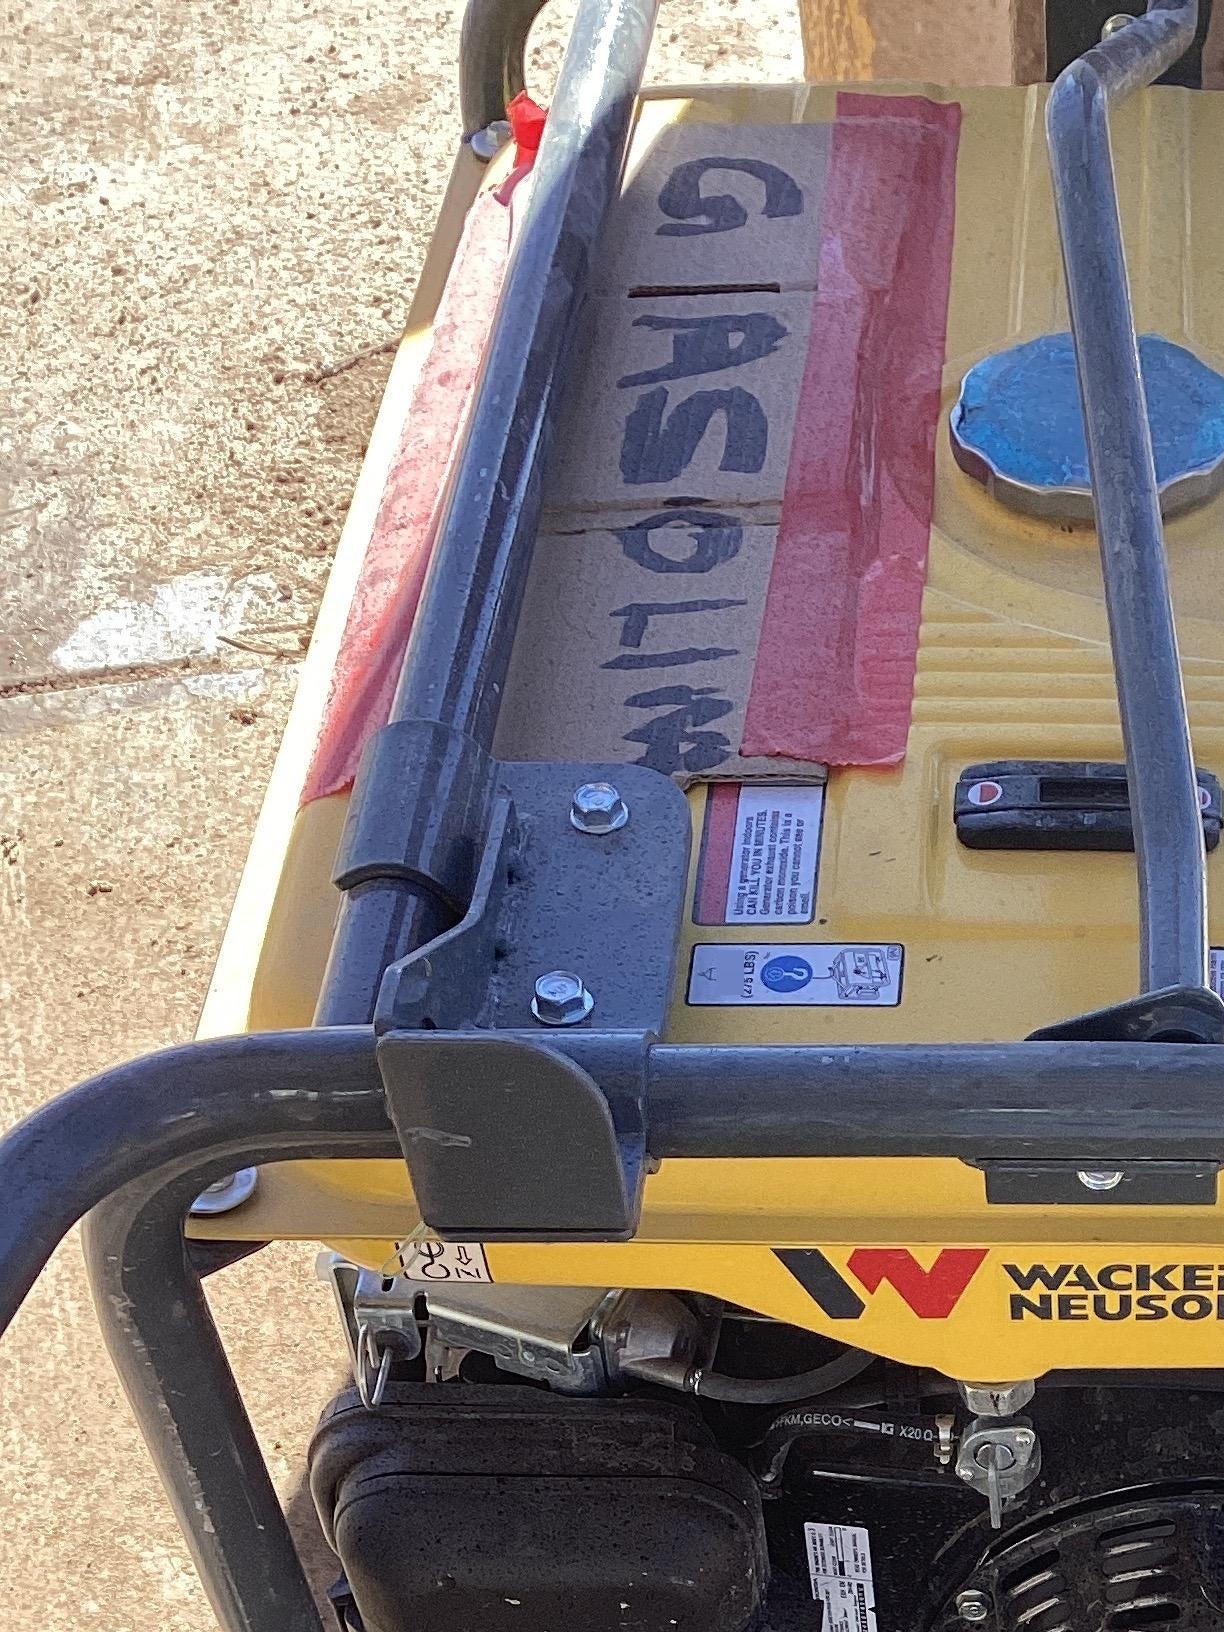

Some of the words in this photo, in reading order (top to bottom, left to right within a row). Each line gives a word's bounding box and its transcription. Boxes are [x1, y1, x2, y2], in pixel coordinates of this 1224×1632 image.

[751, 859, 762, 875] YOU
[748, 878, 760, 895] KILL
[747, 897, 757, 915] CAN
